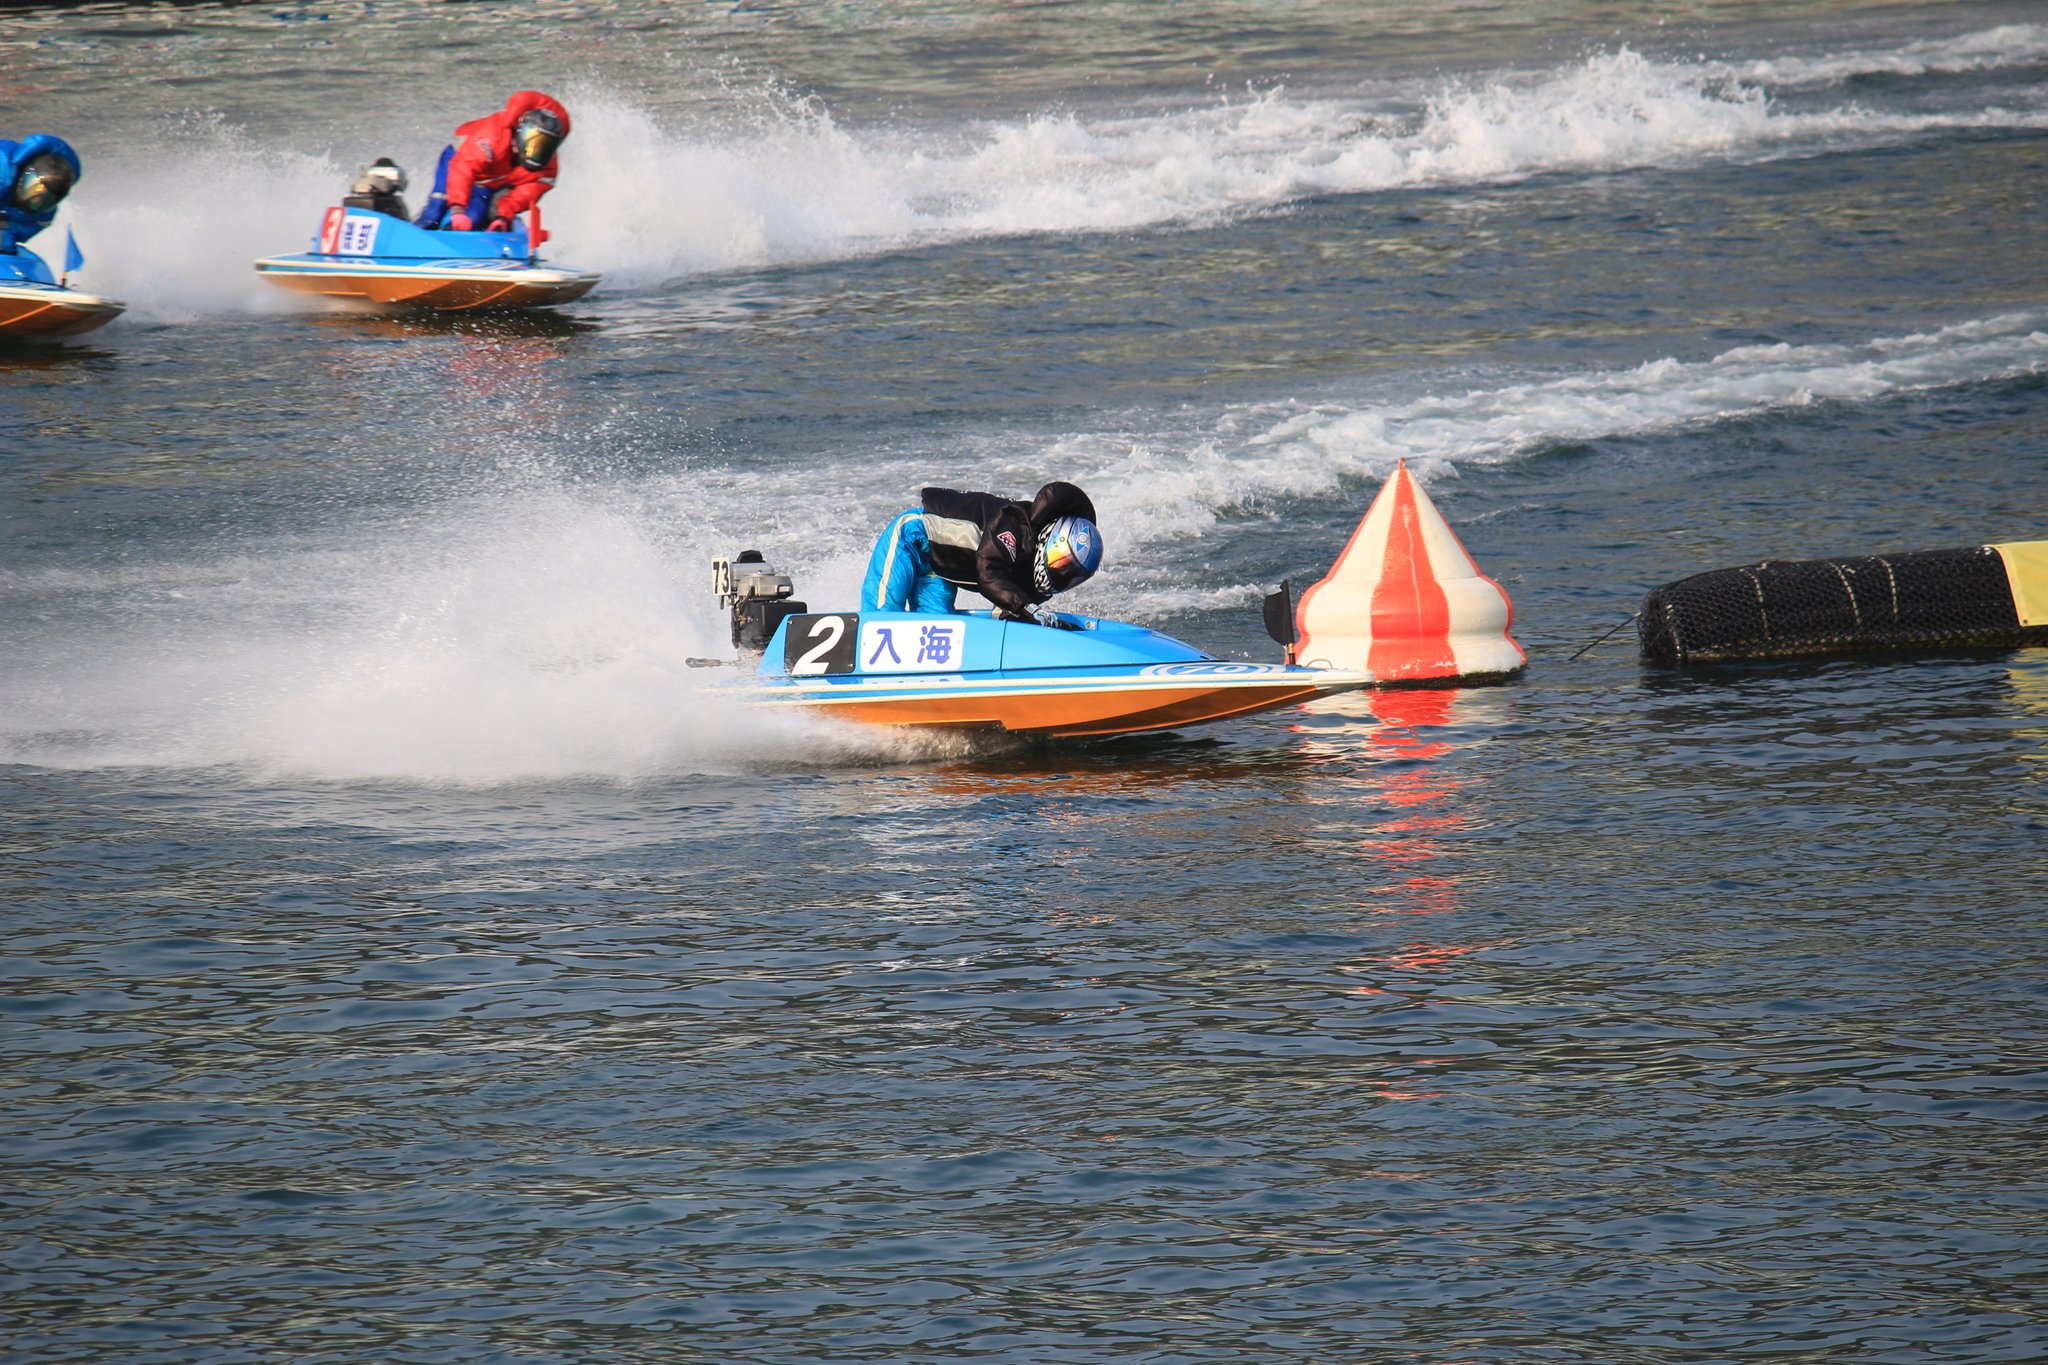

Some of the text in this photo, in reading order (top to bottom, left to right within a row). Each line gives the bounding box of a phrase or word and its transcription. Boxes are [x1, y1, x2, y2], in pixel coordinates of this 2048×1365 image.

[712, 561, 730, 594] 73
[791, 615, 845, 675] 2
[869, 625, 953, 665] 入海
